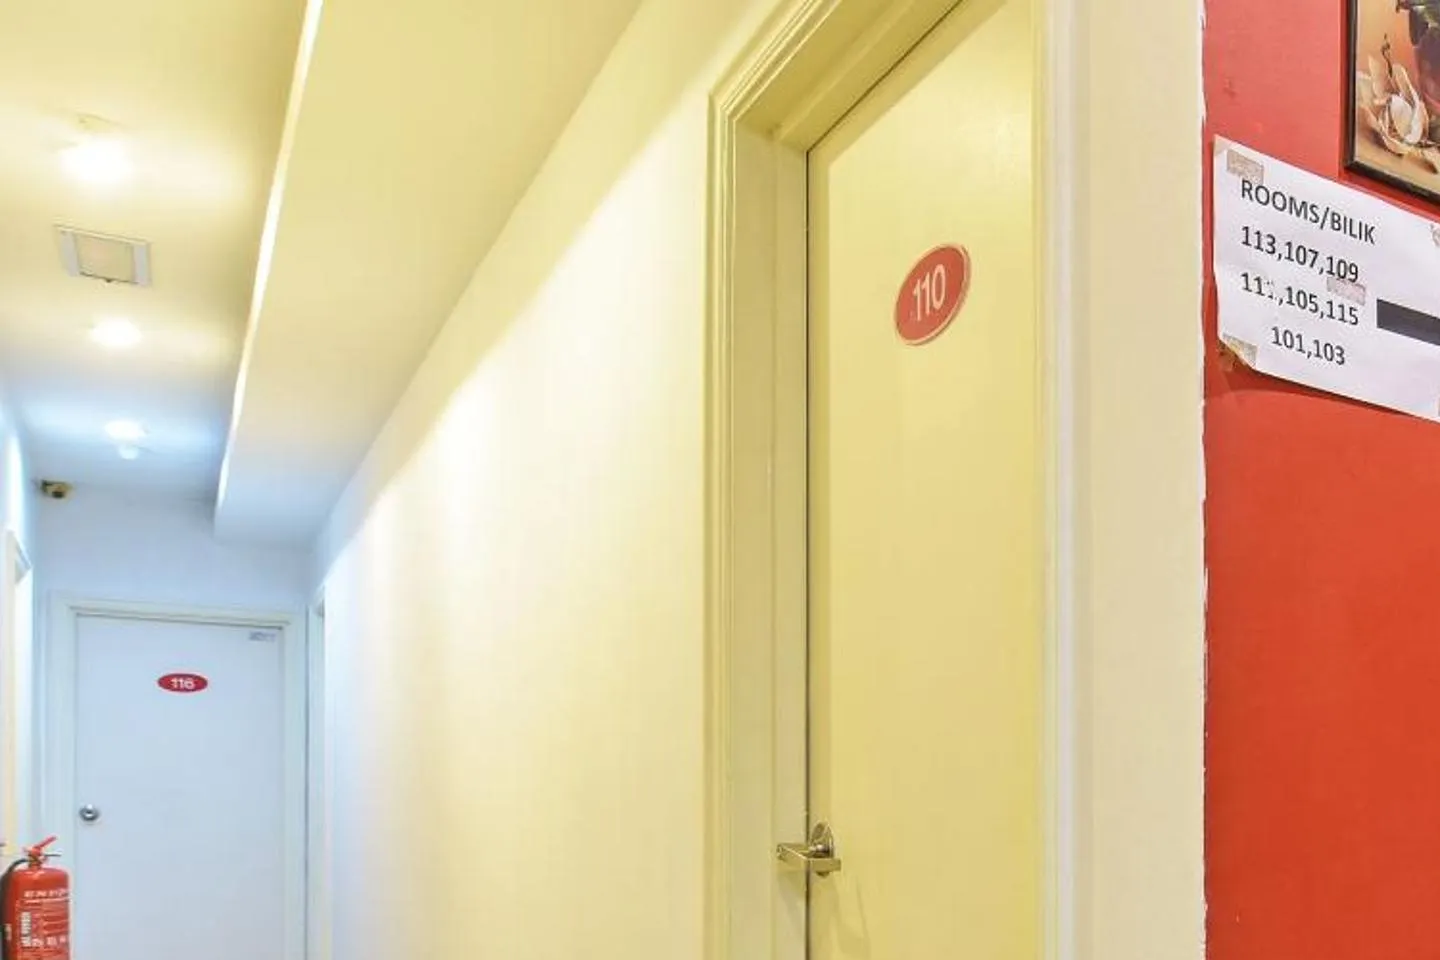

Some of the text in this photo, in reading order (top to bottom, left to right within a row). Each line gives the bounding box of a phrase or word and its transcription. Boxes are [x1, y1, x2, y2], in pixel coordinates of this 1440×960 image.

[1241, 179, 1376, 246] ROOMS/BILIK
[1241, 225, 1360, 284] 113,107,109
[912, 263, 946, 322] 110
[1241, 271, 1359, 327] 11,105,115
[1270, 325, 1347, 367] 101,103
